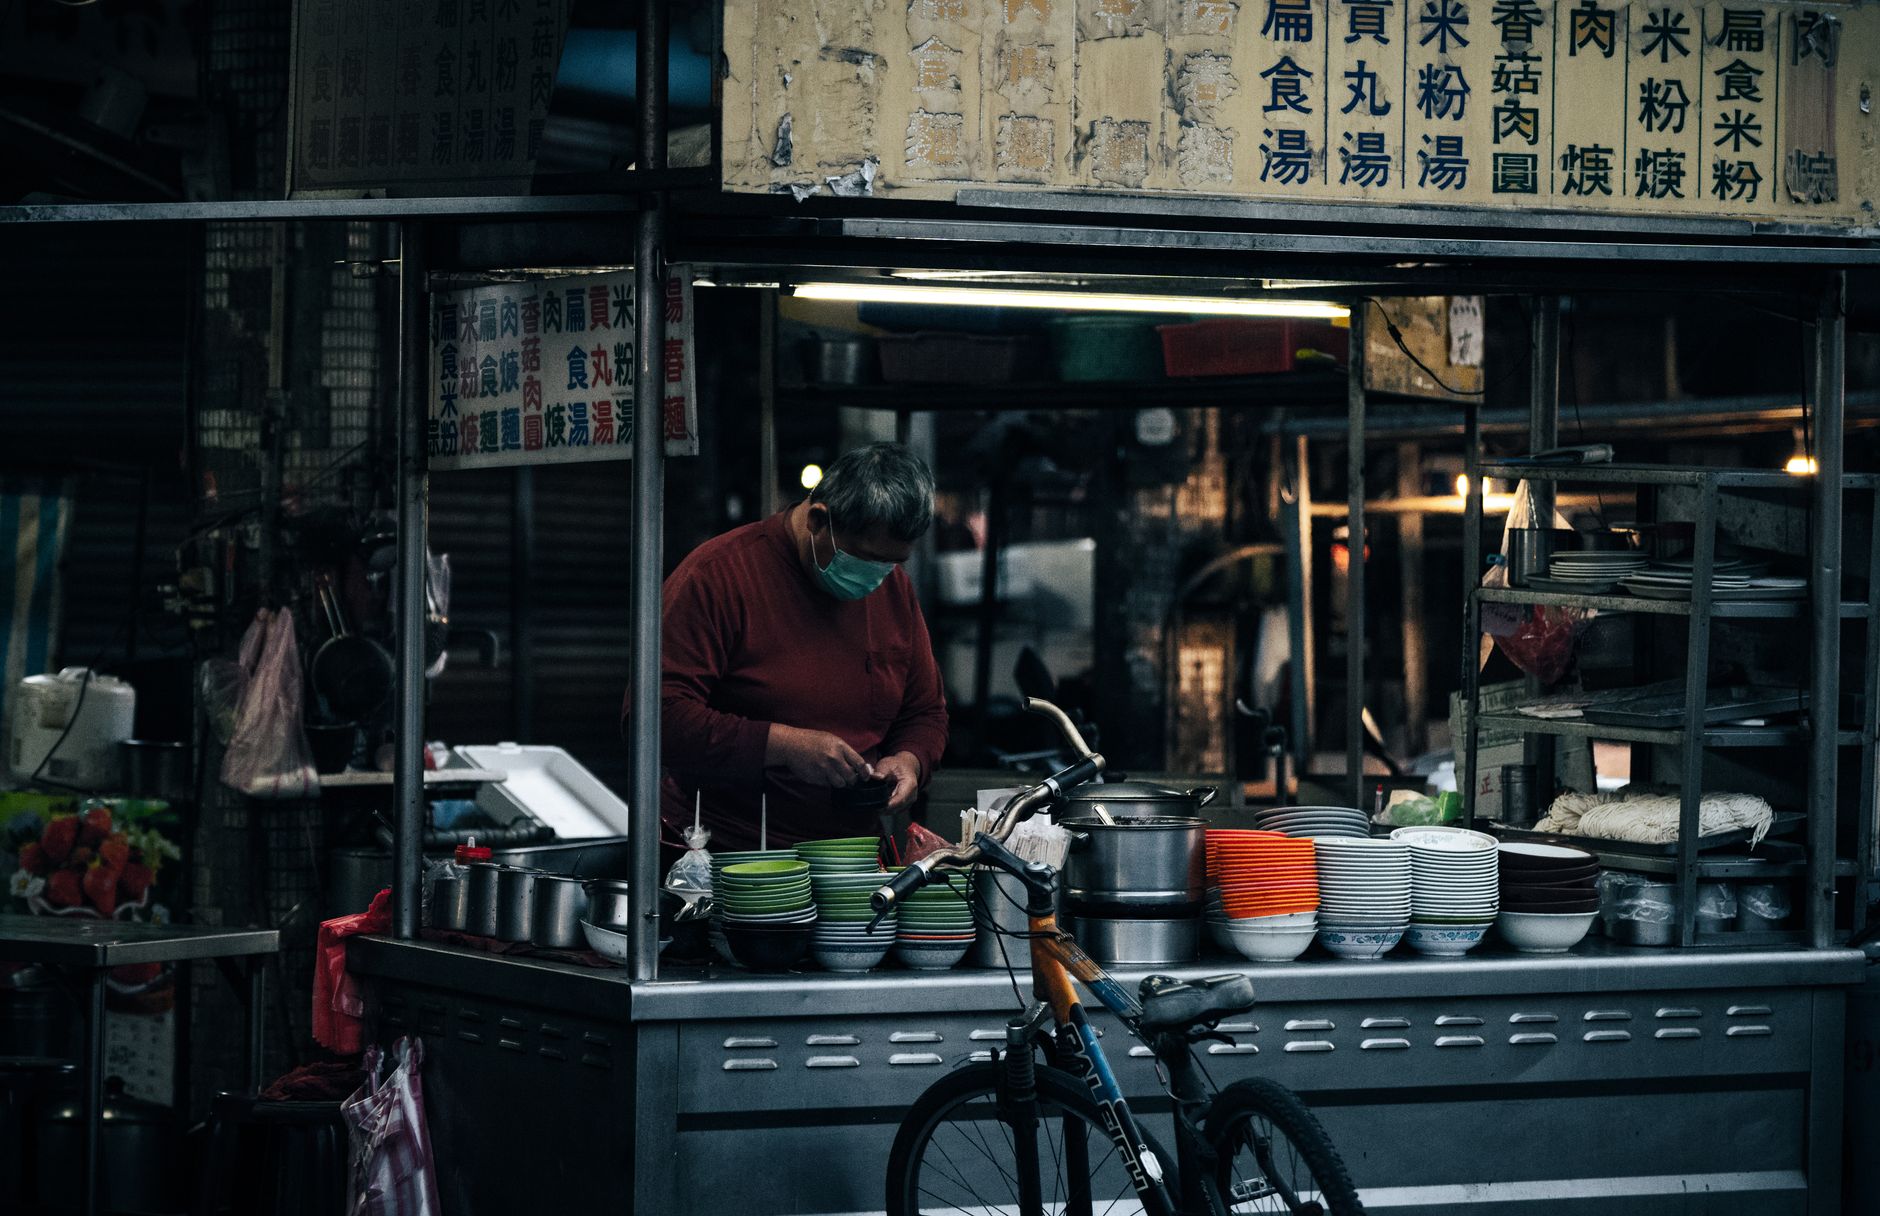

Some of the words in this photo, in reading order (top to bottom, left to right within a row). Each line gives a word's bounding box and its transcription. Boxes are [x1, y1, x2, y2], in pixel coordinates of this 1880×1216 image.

[1259, 0, 1314, 185] 扁食湯
[1338, 0, 1393, 188] 貢丸湯
[1417, 0, 1471, 191] 米粉湯
[1491, 0, 1544, 194] 香菇肉圓
[1711, 7, 1765, 203] 扁食米粉
[440, 304, 458, 457] 扁食米粉
[520, 294, 543, 451] 香菇肉圓
[566, 288, 588, 447] 扁食湯
[589, 285, 613, 445] 貢丸湯
[613, 284, 633, 445] 米粉湯
